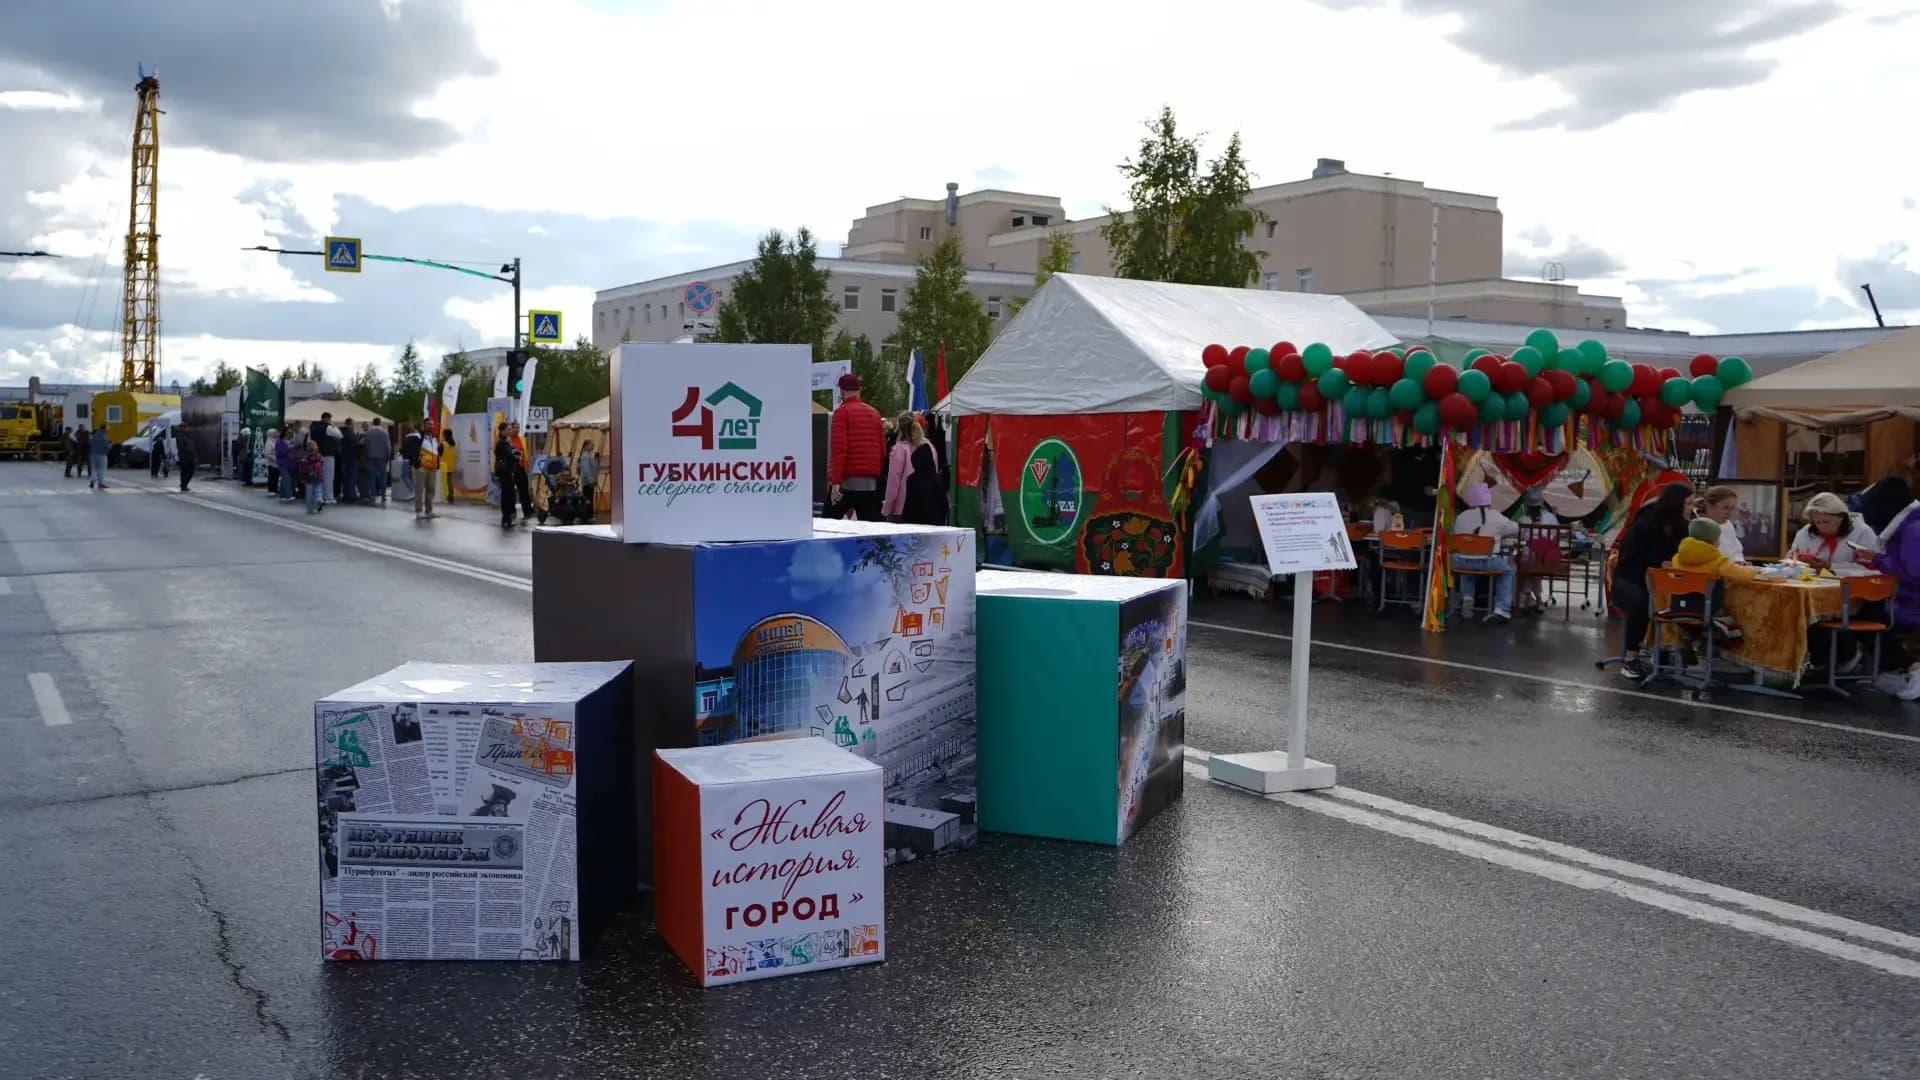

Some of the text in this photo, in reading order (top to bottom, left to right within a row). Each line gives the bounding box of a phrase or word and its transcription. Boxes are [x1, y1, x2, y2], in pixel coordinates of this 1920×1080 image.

[718, 418, 761, 437] лет
[638, 455, 797, 482] ГУБКИНСКИЙ
[637, 474, 798, 507] северное счастье
[347, 828, 464, 845] НЕФТЯНИК
[347, 844, 490, 862] ПРИПОЛЯРЬЯ
[432, 869, 478, 879] российской
[479, 871, 523, 880] экономики
